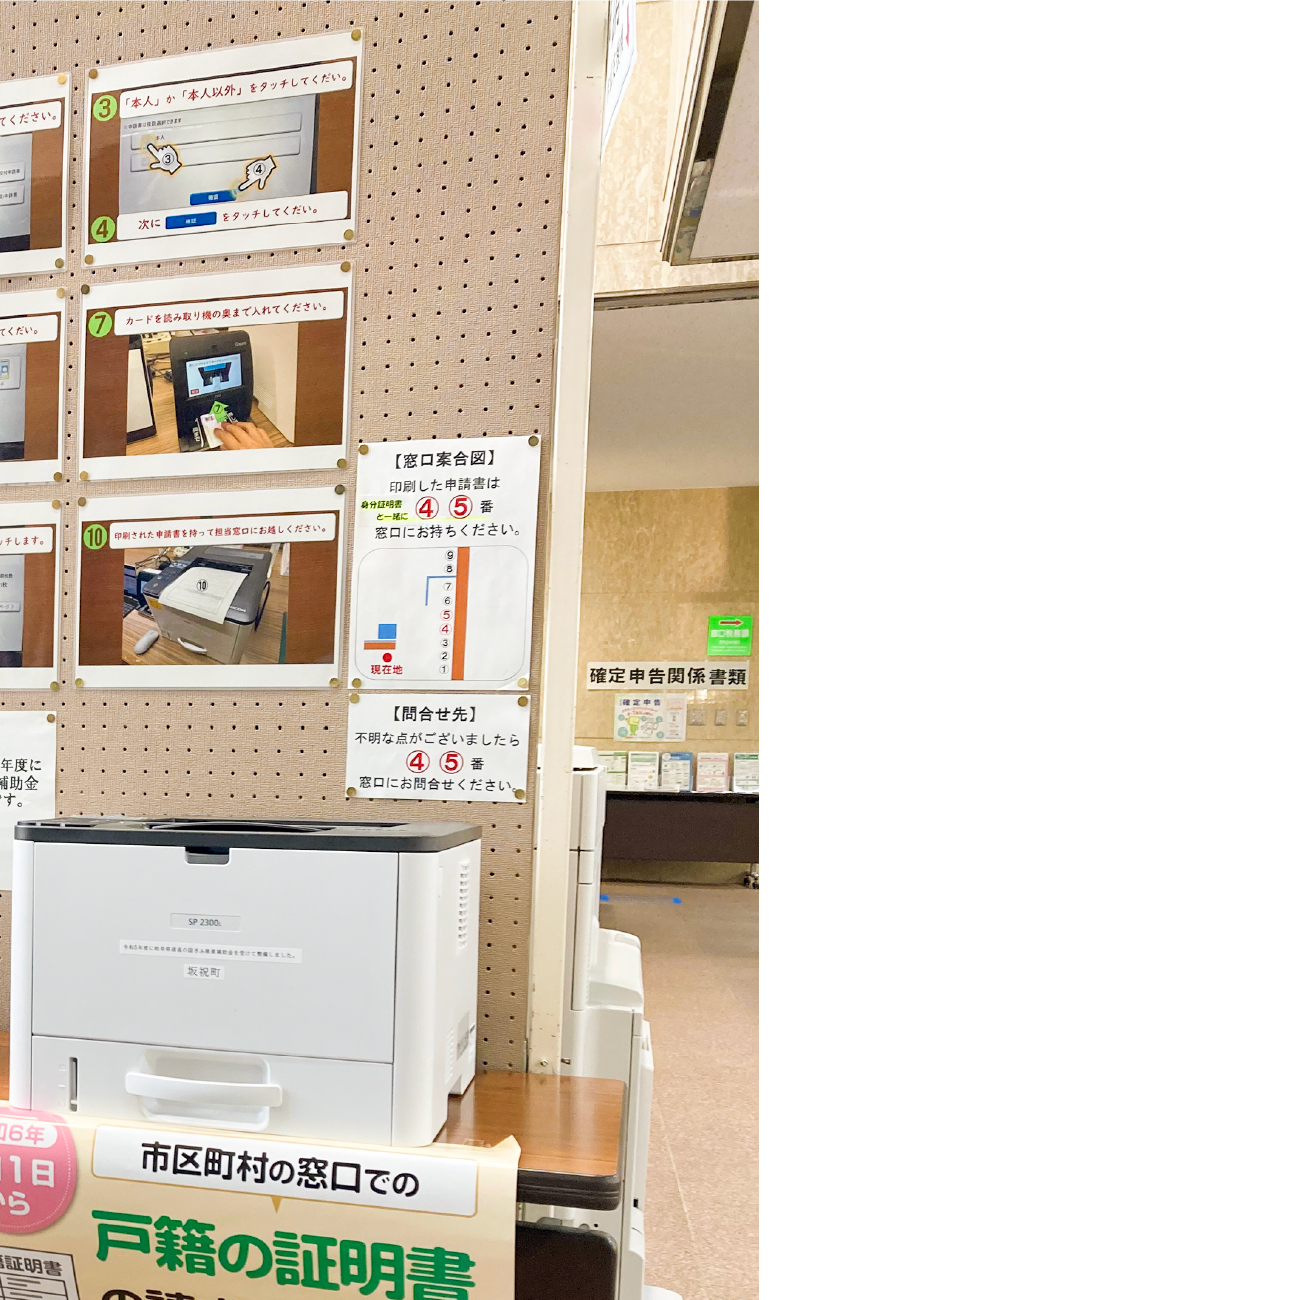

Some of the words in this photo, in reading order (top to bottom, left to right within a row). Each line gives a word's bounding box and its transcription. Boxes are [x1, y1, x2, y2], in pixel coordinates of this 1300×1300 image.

[138, 219, 161, 230] 次に
[222, 204, 318, 222] をタッチしてくだい。
[125, 302, 328, 326] カードを読み取り機の奥まで入れてください。
[394, 449, 496, 470] 【窓口案合図】
[389, 478, 500, 494] 印刷した申請書は
[360, 500, 403, 509] 身分証明書
[480, 500, 493, 514] 番
[376, 513, 409, 521] と一緒に
[114, 524, 326, 541] 印刷された申請書を持って担当窓口にお越しください。
[375, 523, 521, 540] 窓口にお持ちください。
[371, 665, 403, 675] 現在地
[590, 667, 747, 686] 確定申告関係書類
[393, 706, 476, 722] 【問合せ先】
[355, 731, 520, 747] 不明な点がございましたら
[470, 757, 485, 771] 番
[359, 775, 517, 793] 窓口にお問合せください。
[188, 918, 198, 926] SP
[187, 966, 221, 978] 坂祝町
[141, 1141, 420, 1197] 市区町村の窓口での
[91, 1210, 476, 1300] 戸籍の証明書
